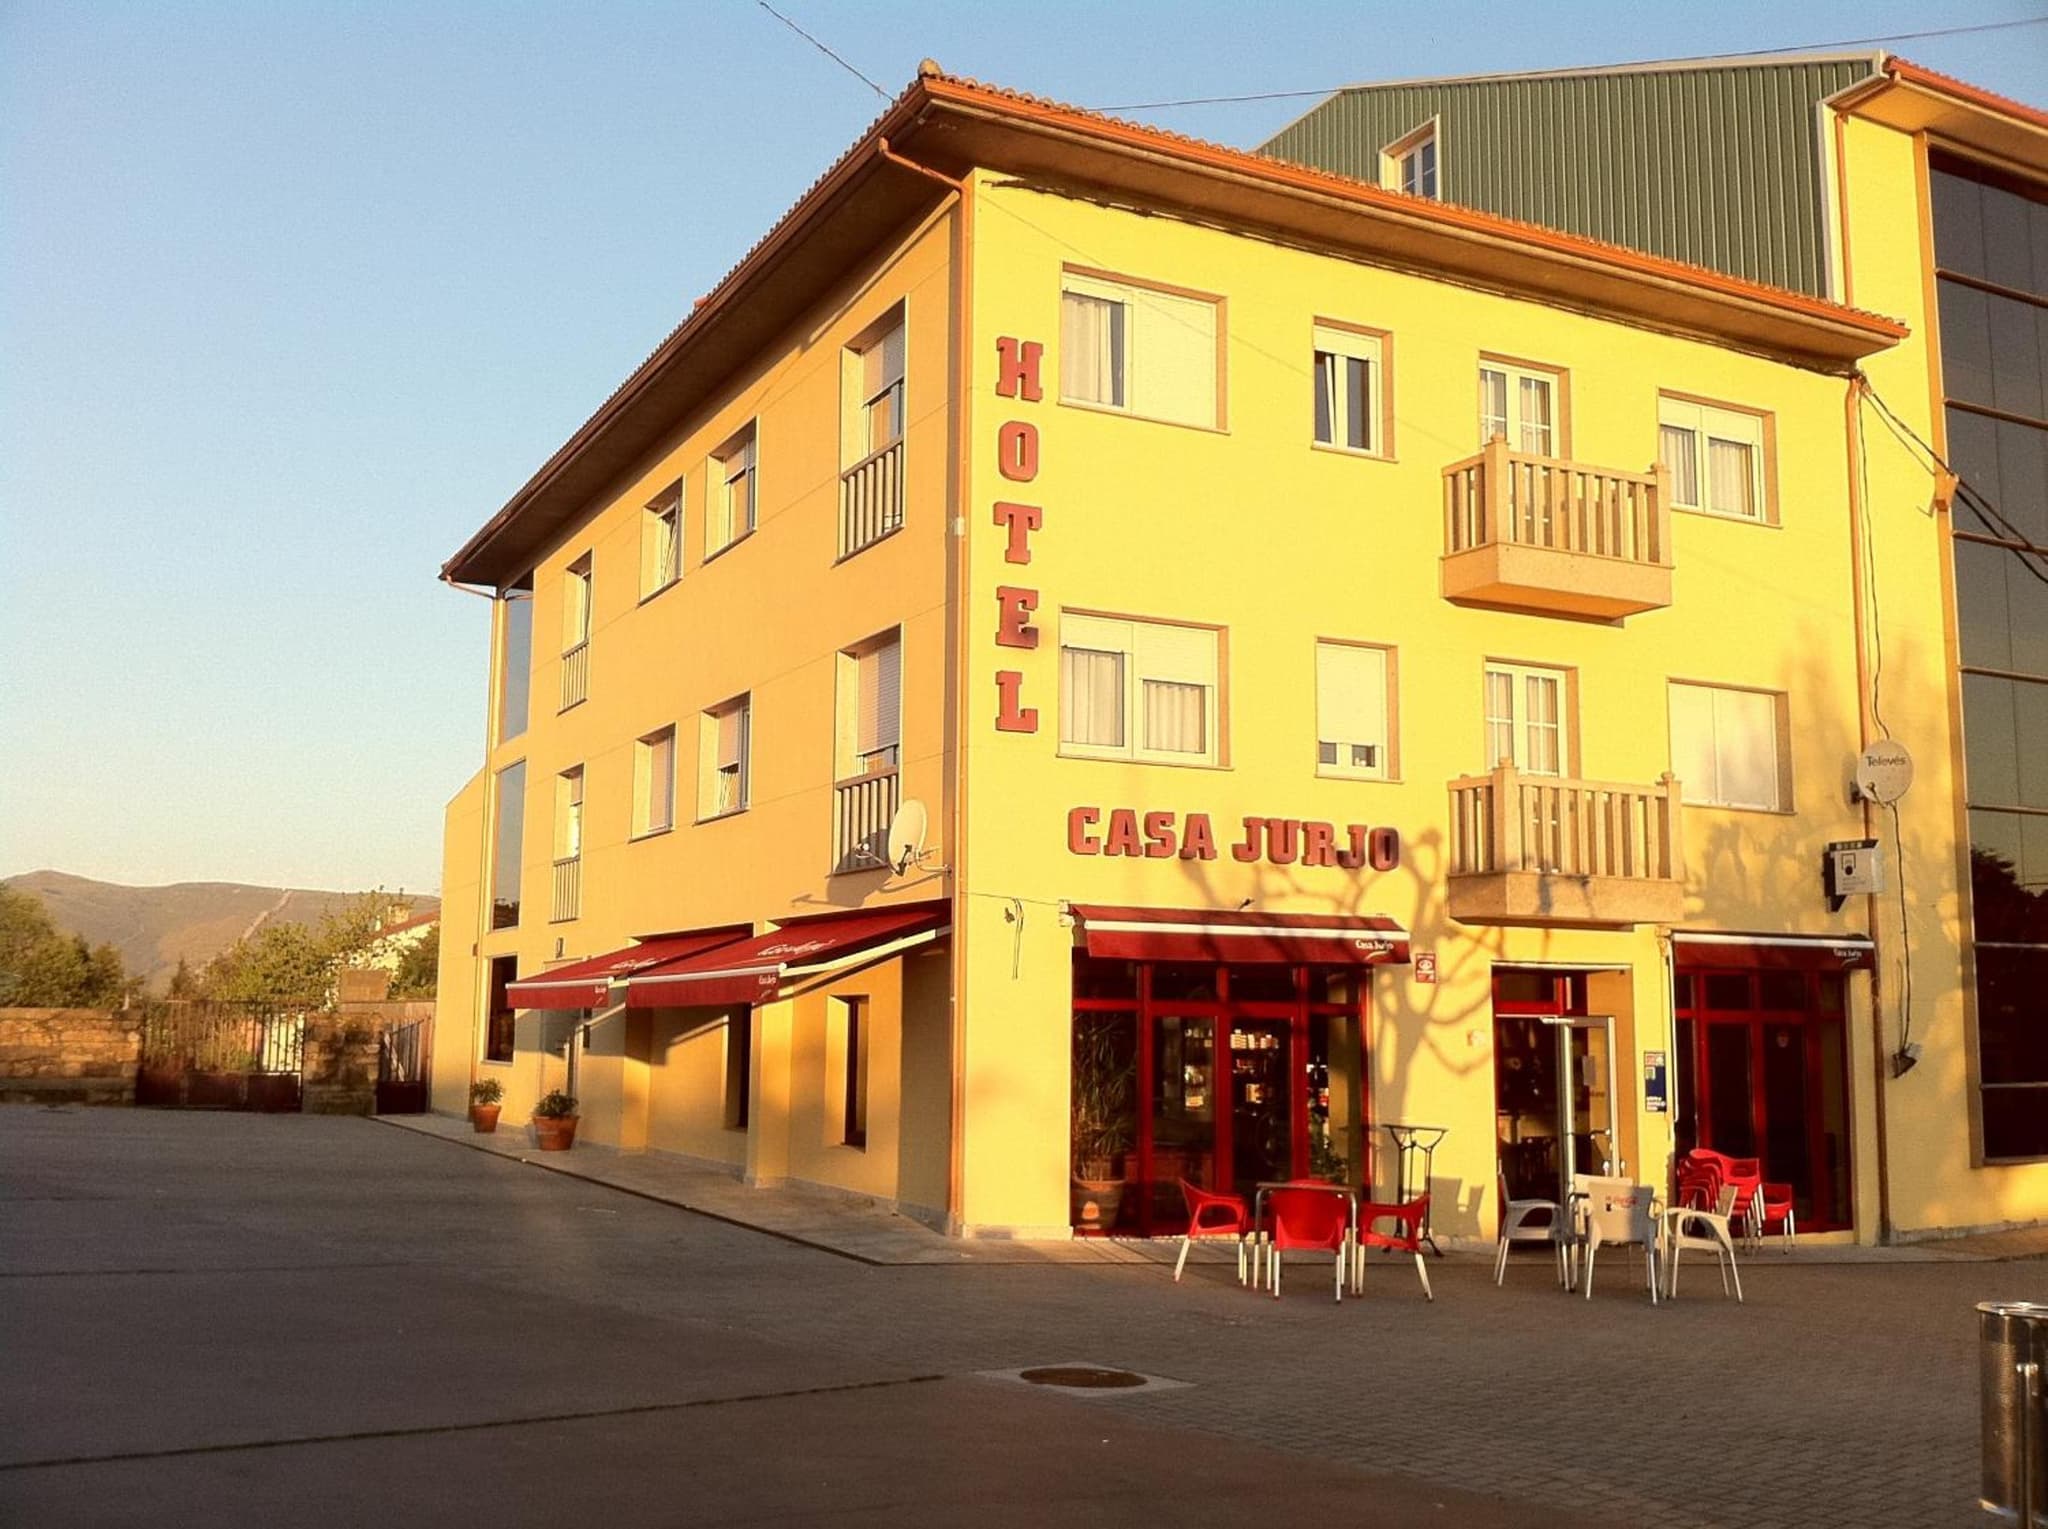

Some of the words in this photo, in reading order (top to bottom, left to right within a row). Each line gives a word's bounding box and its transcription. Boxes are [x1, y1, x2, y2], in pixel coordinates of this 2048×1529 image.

[993, 335, 1043, 733] HOTEL
[1067, 806, 1218, 861] CASA
[1231, 816, 1401, 872] JURJO
[1355, 938, 1374, 950] Casa
